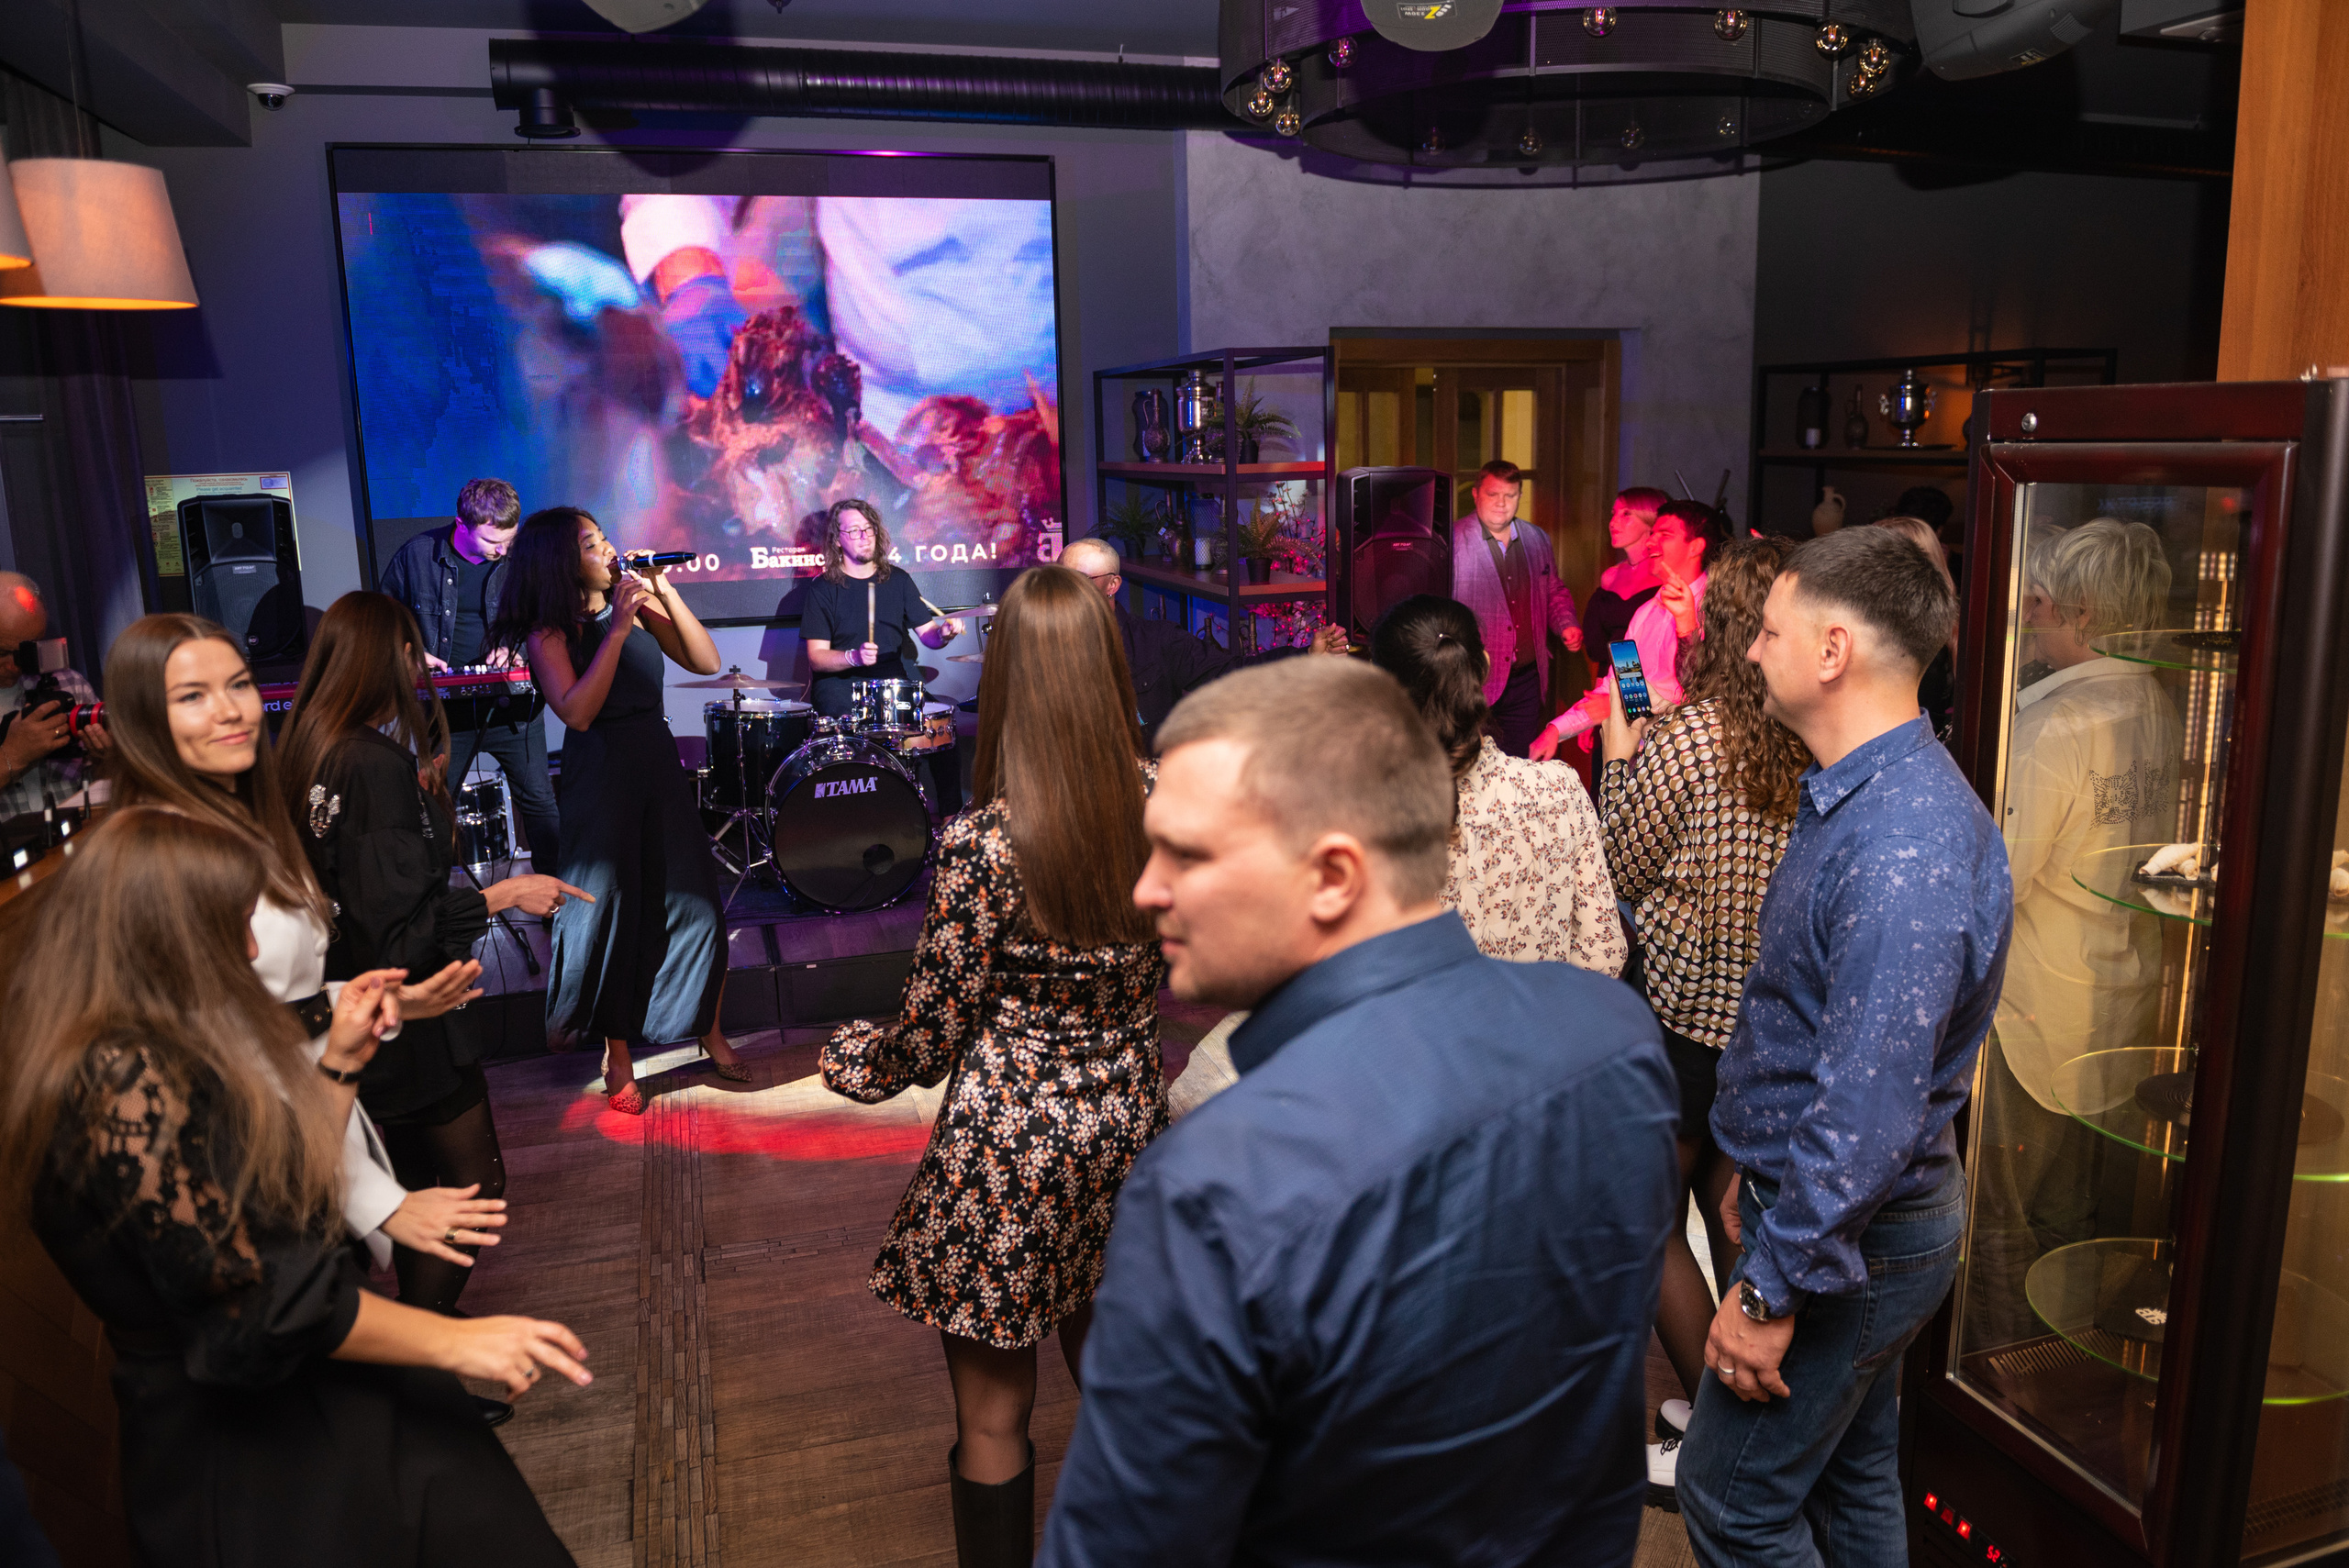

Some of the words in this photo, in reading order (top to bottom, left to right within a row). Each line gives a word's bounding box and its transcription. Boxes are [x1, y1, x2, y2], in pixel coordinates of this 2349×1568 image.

[750, 547, 826, 569] Бакинс
[915, 542, 997, 563] ГОДА!
[826, 776, 877, 797] TAMA
